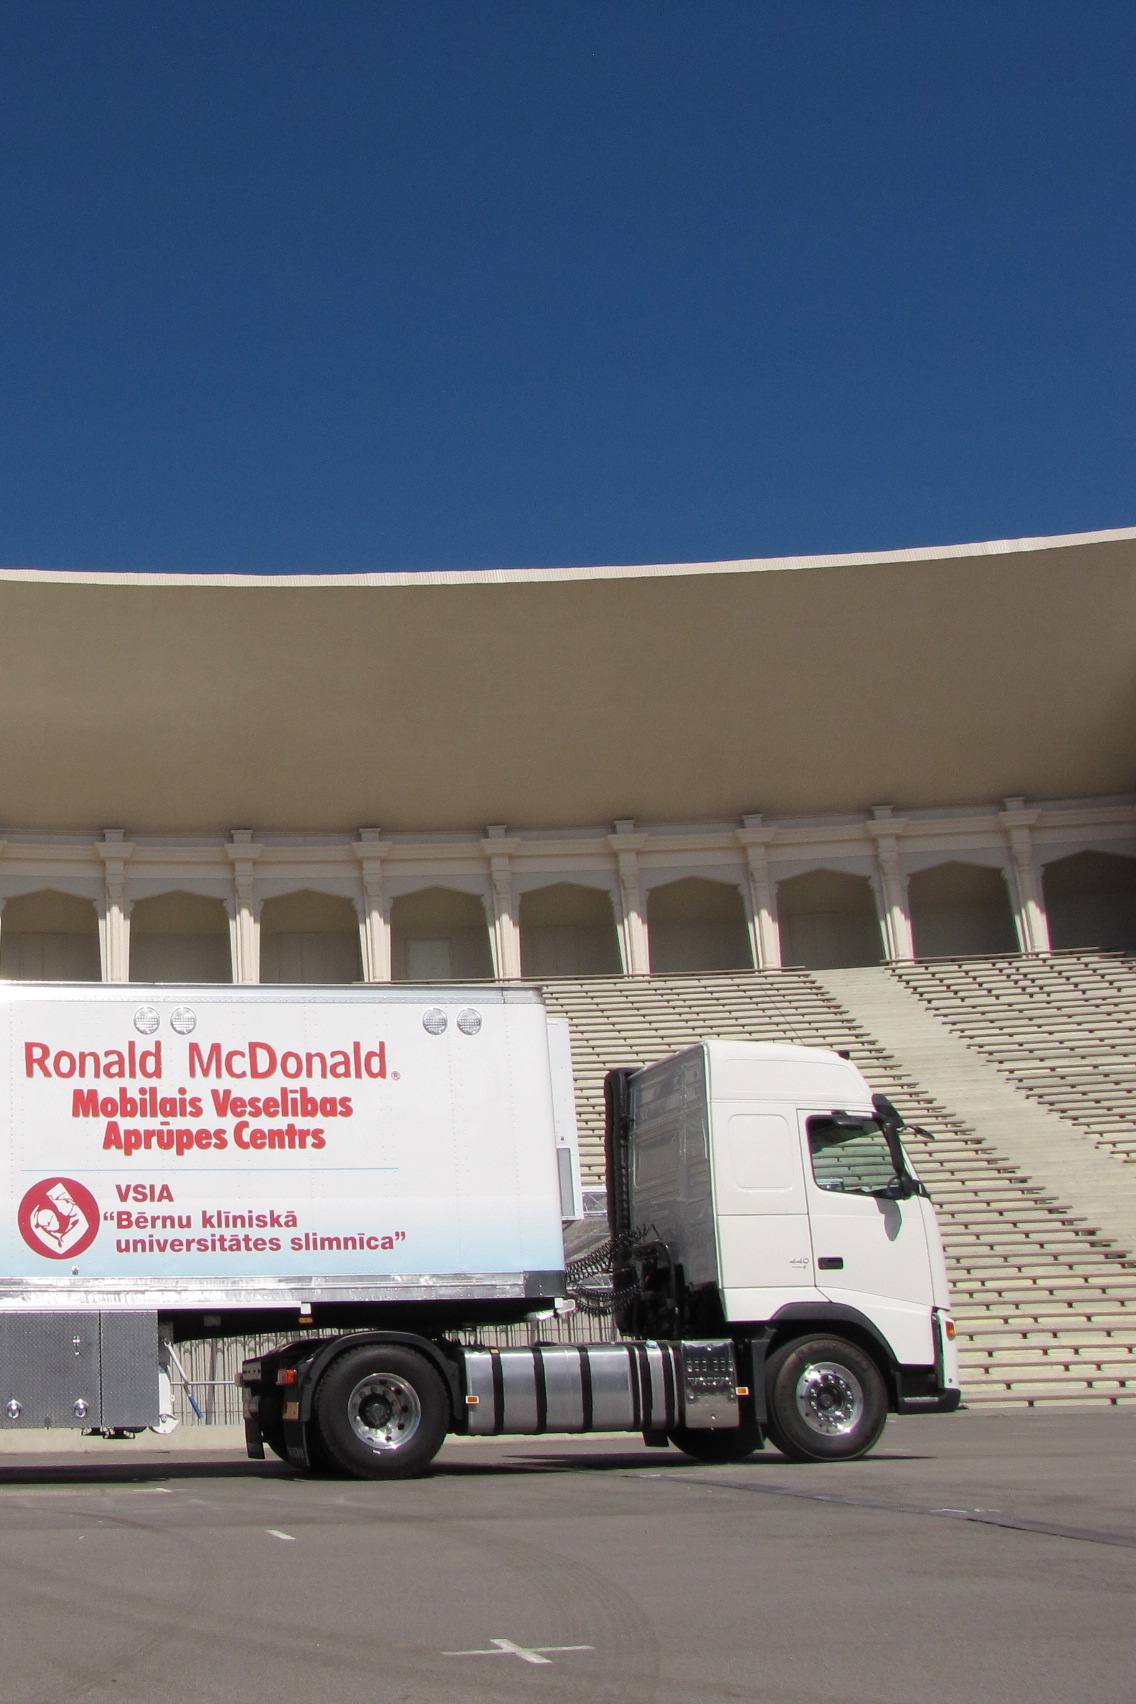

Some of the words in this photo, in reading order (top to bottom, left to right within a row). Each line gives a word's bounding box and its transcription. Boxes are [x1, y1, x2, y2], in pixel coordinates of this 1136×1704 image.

[24, 1040, 162, 1079] Ronald
[188, 1041, 386, 1080] McDonald
[72, 1086, 204, 1118] Mobilais
[210, 1086, 354, 1118] Veselības
[102, 1121, 229, 1156] Aprūpes
[233, 1120, 326, 1150] Centrs
[115, 1183, 175, 1203] VSIA
[201, 1209, 298, 1229] klīniskā
[116, 1234, 282, 1253] universitātes
